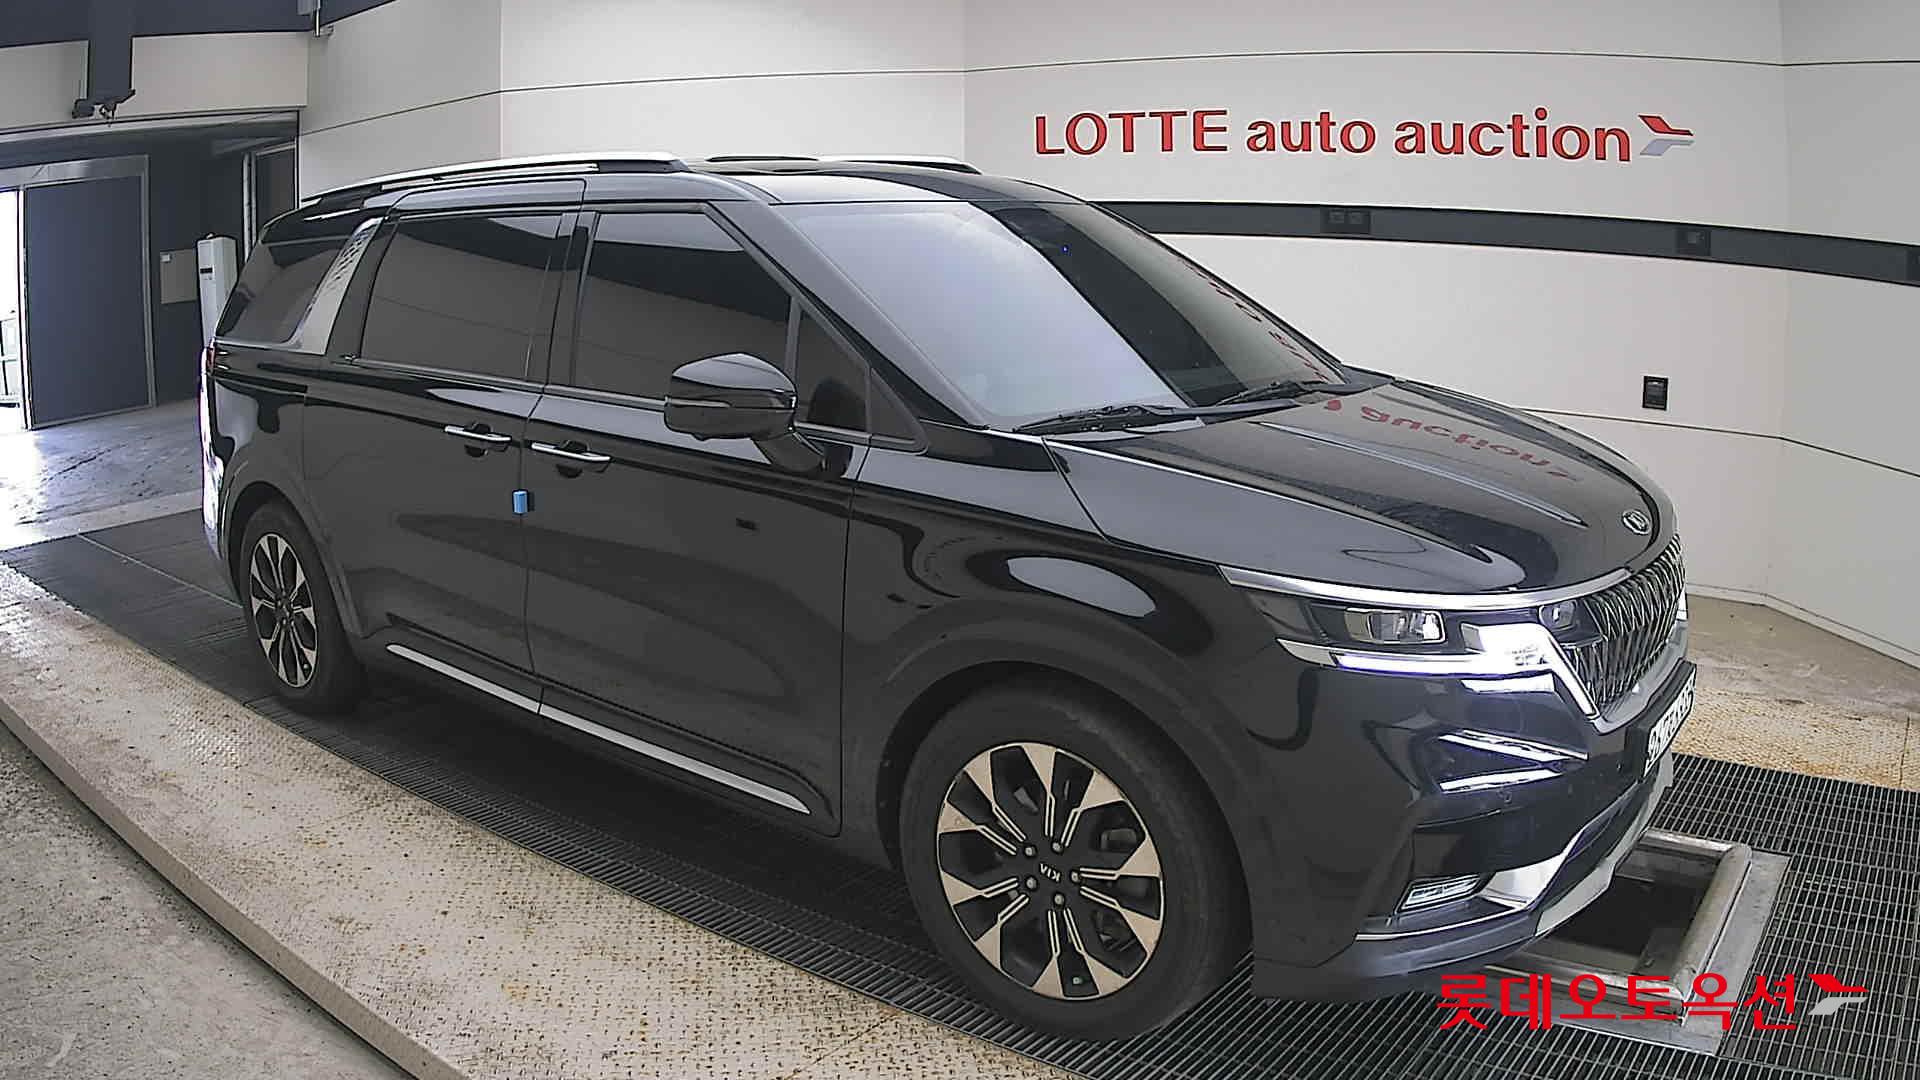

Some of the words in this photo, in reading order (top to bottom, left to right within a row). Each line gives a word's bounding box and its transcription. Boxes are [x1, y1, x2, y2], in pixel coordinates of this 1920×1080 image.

[1034, 110, 1227, 155] LOTTE
[1247, 111, 1377, 154] auto
[1394, 107, 1631, 162] auction
[1040, 863, 1061, 882] KIA
